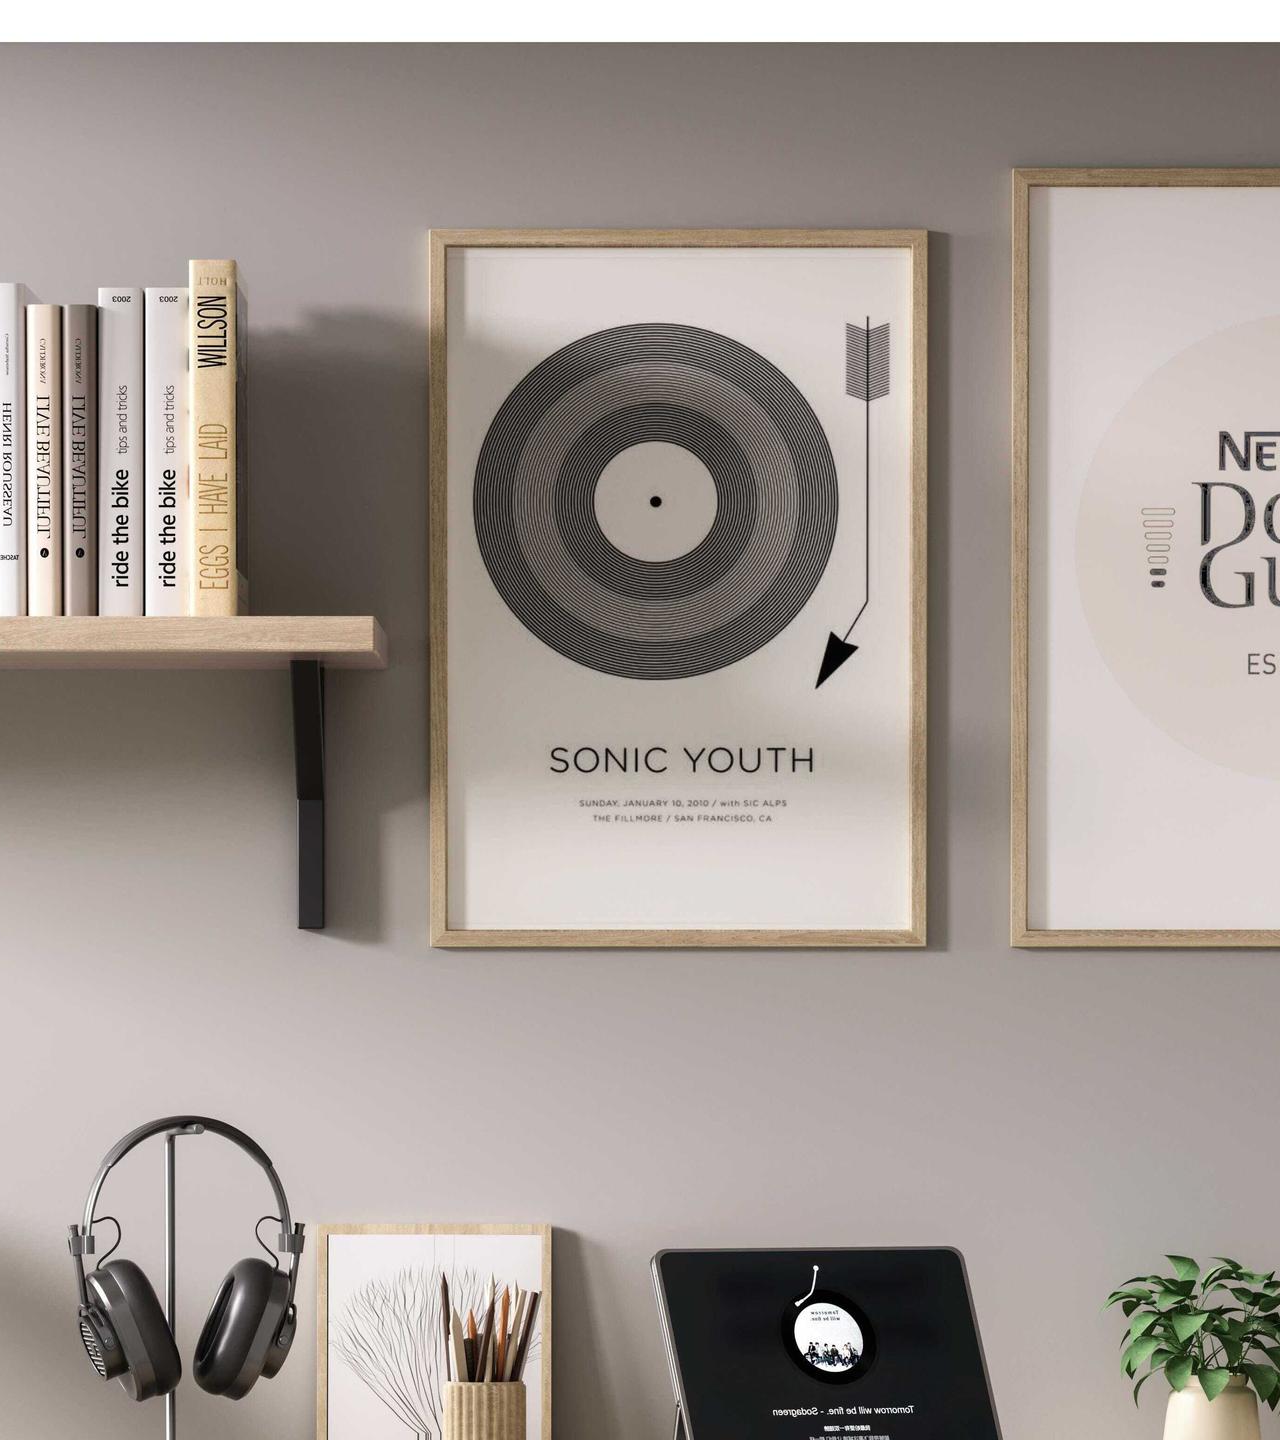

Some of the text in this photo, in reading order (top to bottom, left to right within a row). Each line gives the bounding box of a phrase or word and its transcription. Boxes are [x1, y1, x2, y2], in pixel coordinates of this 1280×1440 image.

[111, 295, 132, 303] 2003
[159, 295, 179, 303] 2003
[196, 295, 228, 369] WILLSON
[198, 422, 229, 460] LAID
[111, 385, 130, 587] ride the bike tips and tricks
[158, 384, 177, 587] ride the bike tips and tricks
[198, 472, 228, 514] HAVE
[199, 544, 229, 590] EGGS
[550, 746, 813, 774] SONIC YOUTH
[593, 814, 611, 823] THE
[614, 814, 662, 823] FILLMORE
[674, 814, 694, 823] SAN
[758, 814, 772, 823] CA
[623, 799, 668, 807] JANUARY
[687, 799, 710, 808] 2010
[719, 799, 740, 807] with
[743, 799, 759, 808] SIC
[762, 799, 787, 807] ALPS
